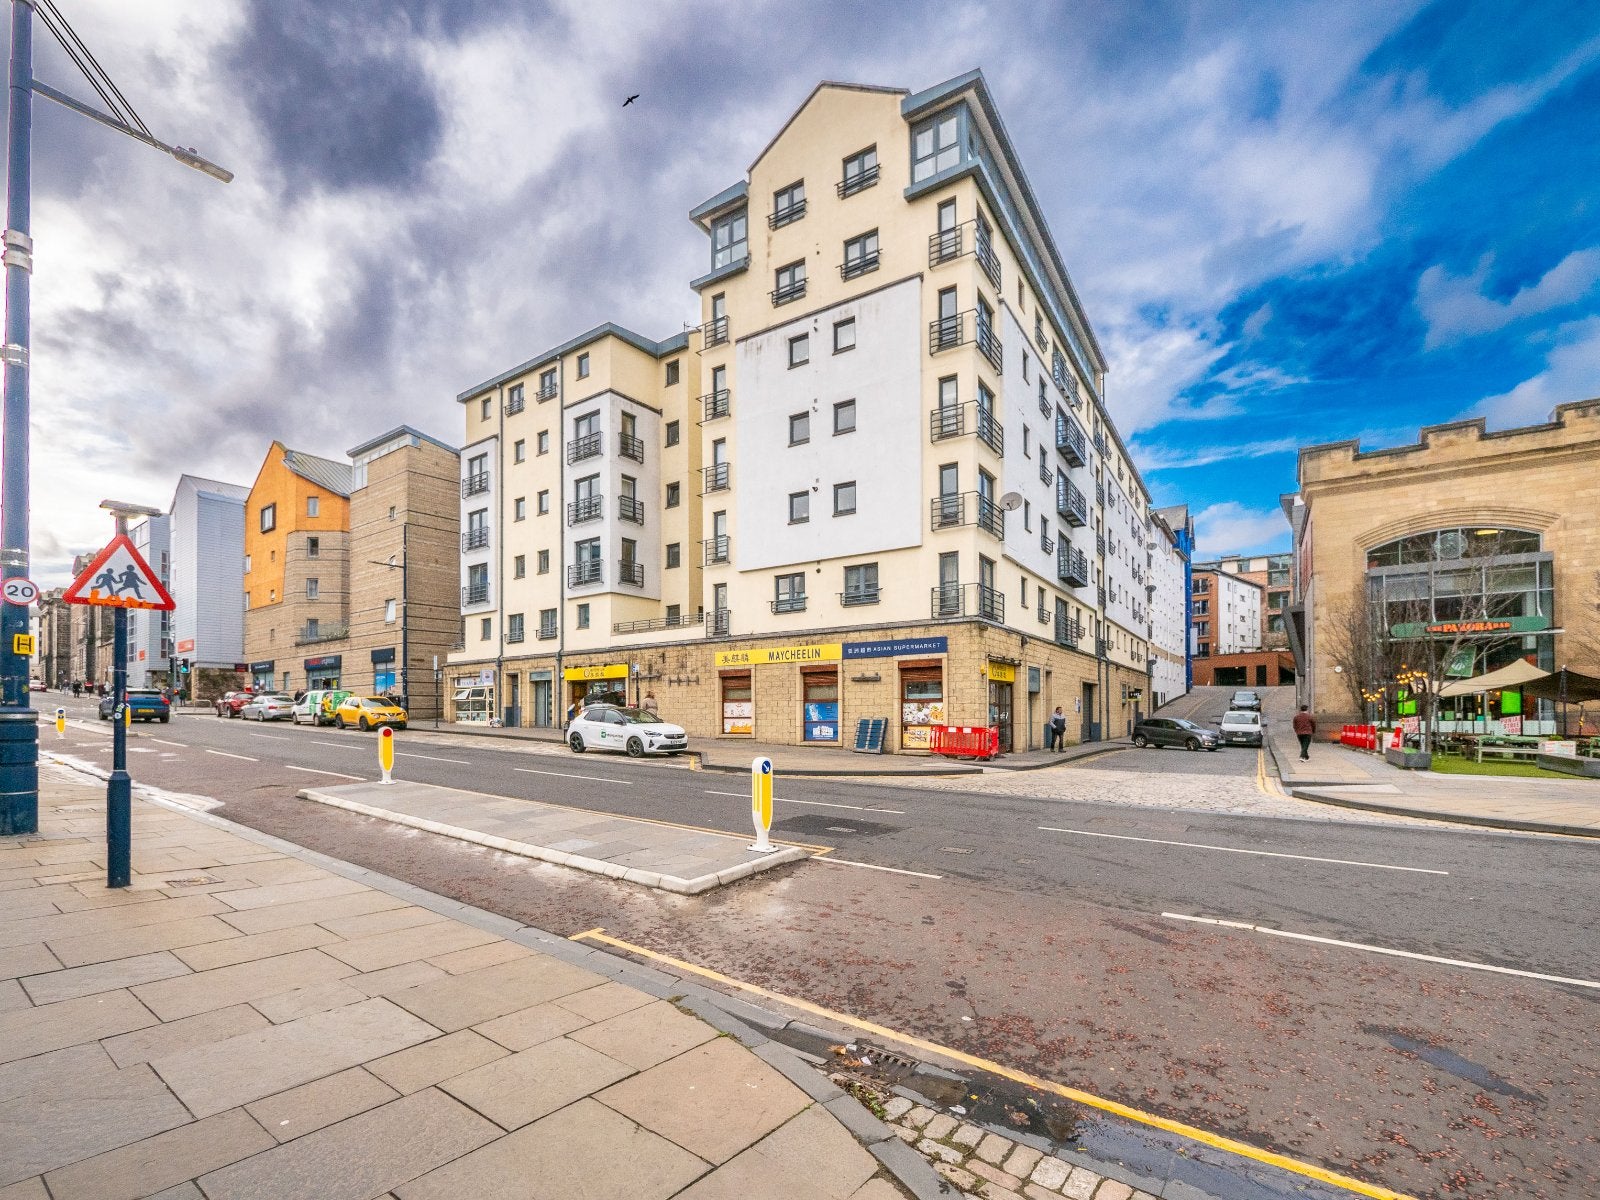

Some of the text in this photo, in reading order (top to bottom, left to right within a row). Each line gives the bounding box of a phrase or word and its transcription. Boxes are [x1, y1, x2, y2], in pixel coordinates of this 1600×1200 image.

[7, 584, 34, 598] 20
[17, 636, 32, 653] H
[893, 642, 941, 651] SUPERMARKET
[768, 648, 821, 662] MAYCHEELIN
